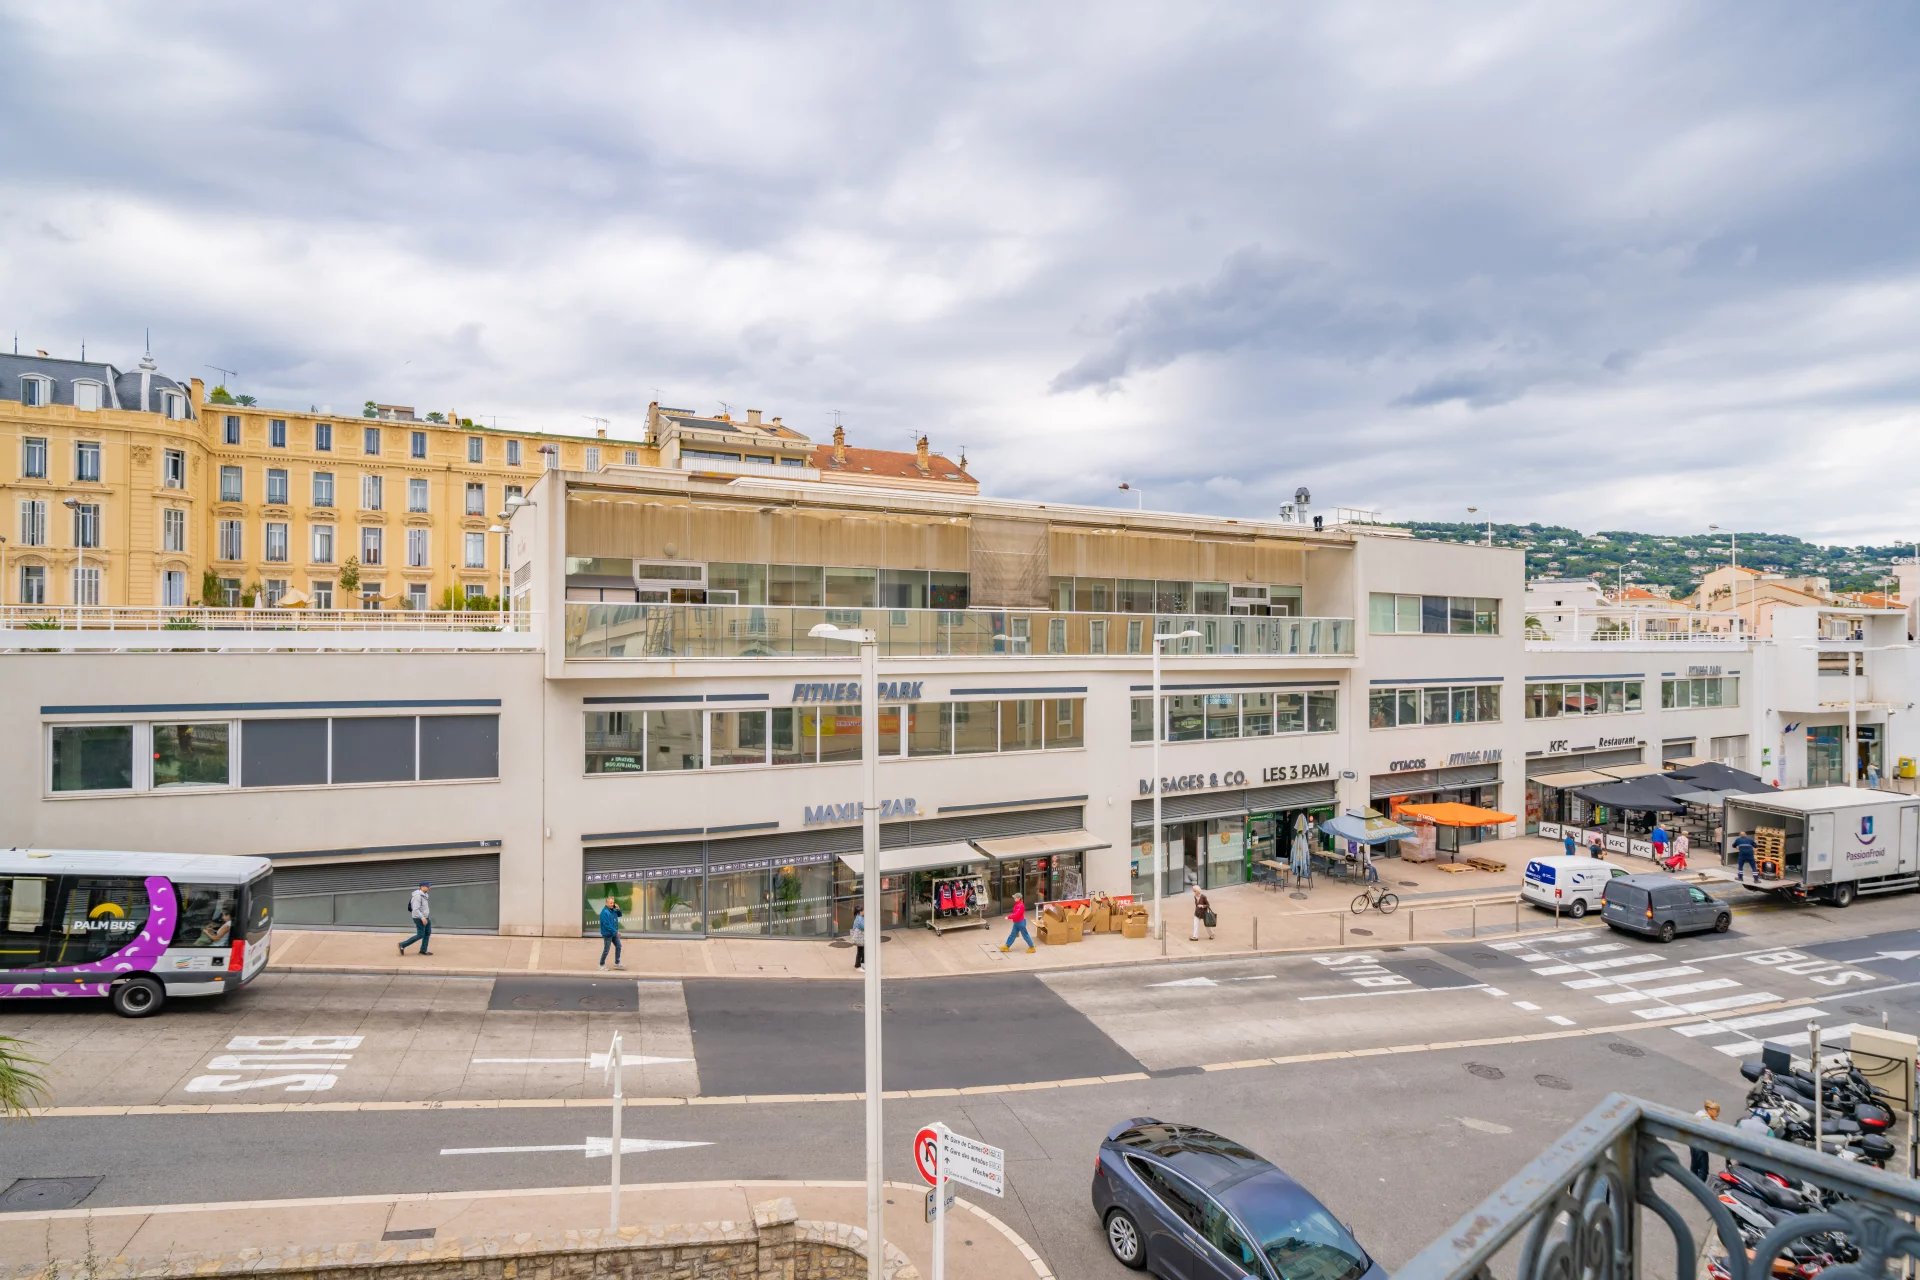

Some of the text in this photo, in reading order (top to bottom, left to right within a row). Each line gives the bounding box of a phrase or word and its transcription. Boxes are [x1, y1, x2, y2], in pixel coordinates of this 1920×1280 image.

[792, 681, 923, 702] FITNES PARK
[1549, 736, 1636, 753] KFC Restaurant
[1390, 758, 1426, 772] O'TACOS
[1448, 748, 1503, 766] FITNESS PARK
[1209, 772, 1219, 787] &
[1263, 766, 1287, 783] LES
[1290, 765, 1298, 779] 3
[1302, 762, 1330, 778] PAM
[804, 797, 917, 825] MAXI ZAR
[1541, 826, 1559, 835] KFC
[1608, 838, 1626, 848] KFC
[1632, 844, 1650, 854] KFC
[1846, 848, 1886, 861] PassionFroid
[74, 921, 136, 930] PALM BUS
[1311, 955, 1413, 987] BUS
[1743, 950, 1877, 985] BUS
[183, 1035, 366, 1092] BUS
